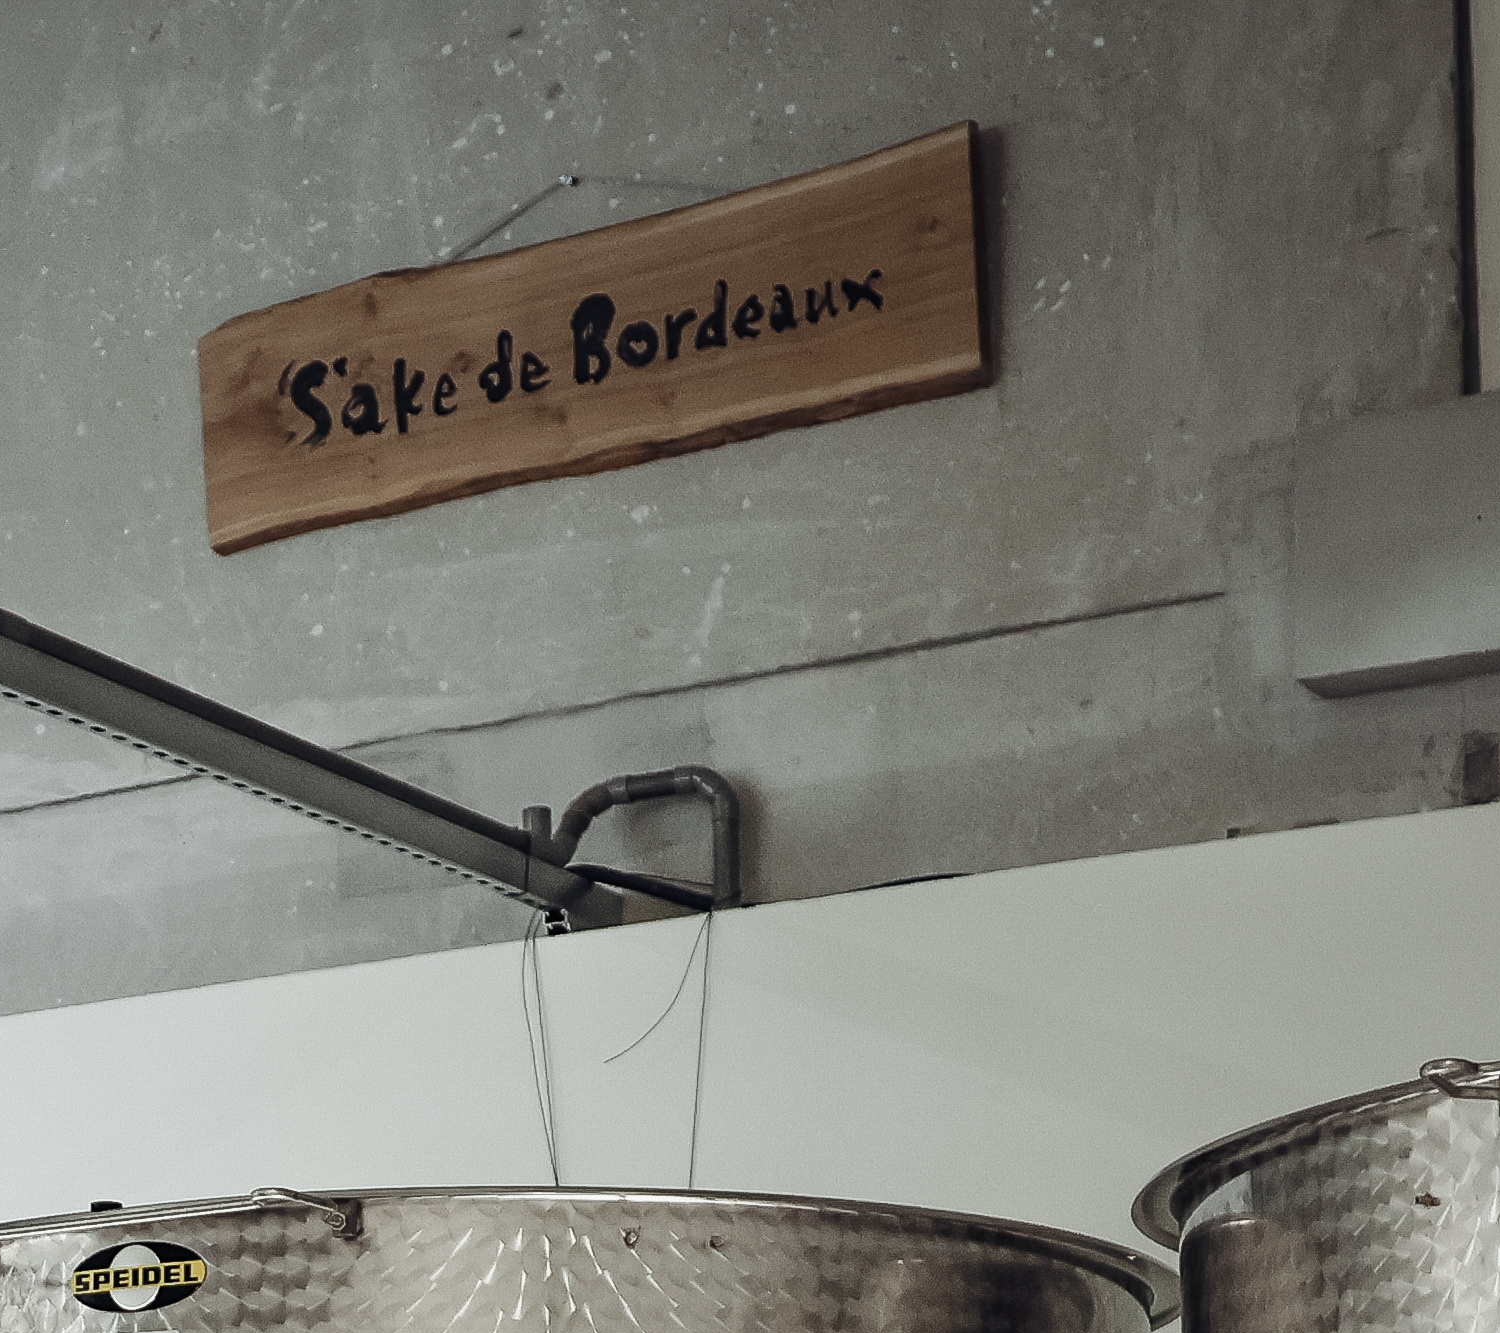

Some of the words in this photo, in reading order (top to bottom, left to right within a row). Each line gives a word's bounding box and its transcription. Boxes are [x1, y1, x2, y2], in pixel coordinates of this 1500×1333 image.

[478, 329, 551, 403] de
[570, 269, 884, 384] Bordeaux
[75, 1263, 199, 1292] SPEIDEL
